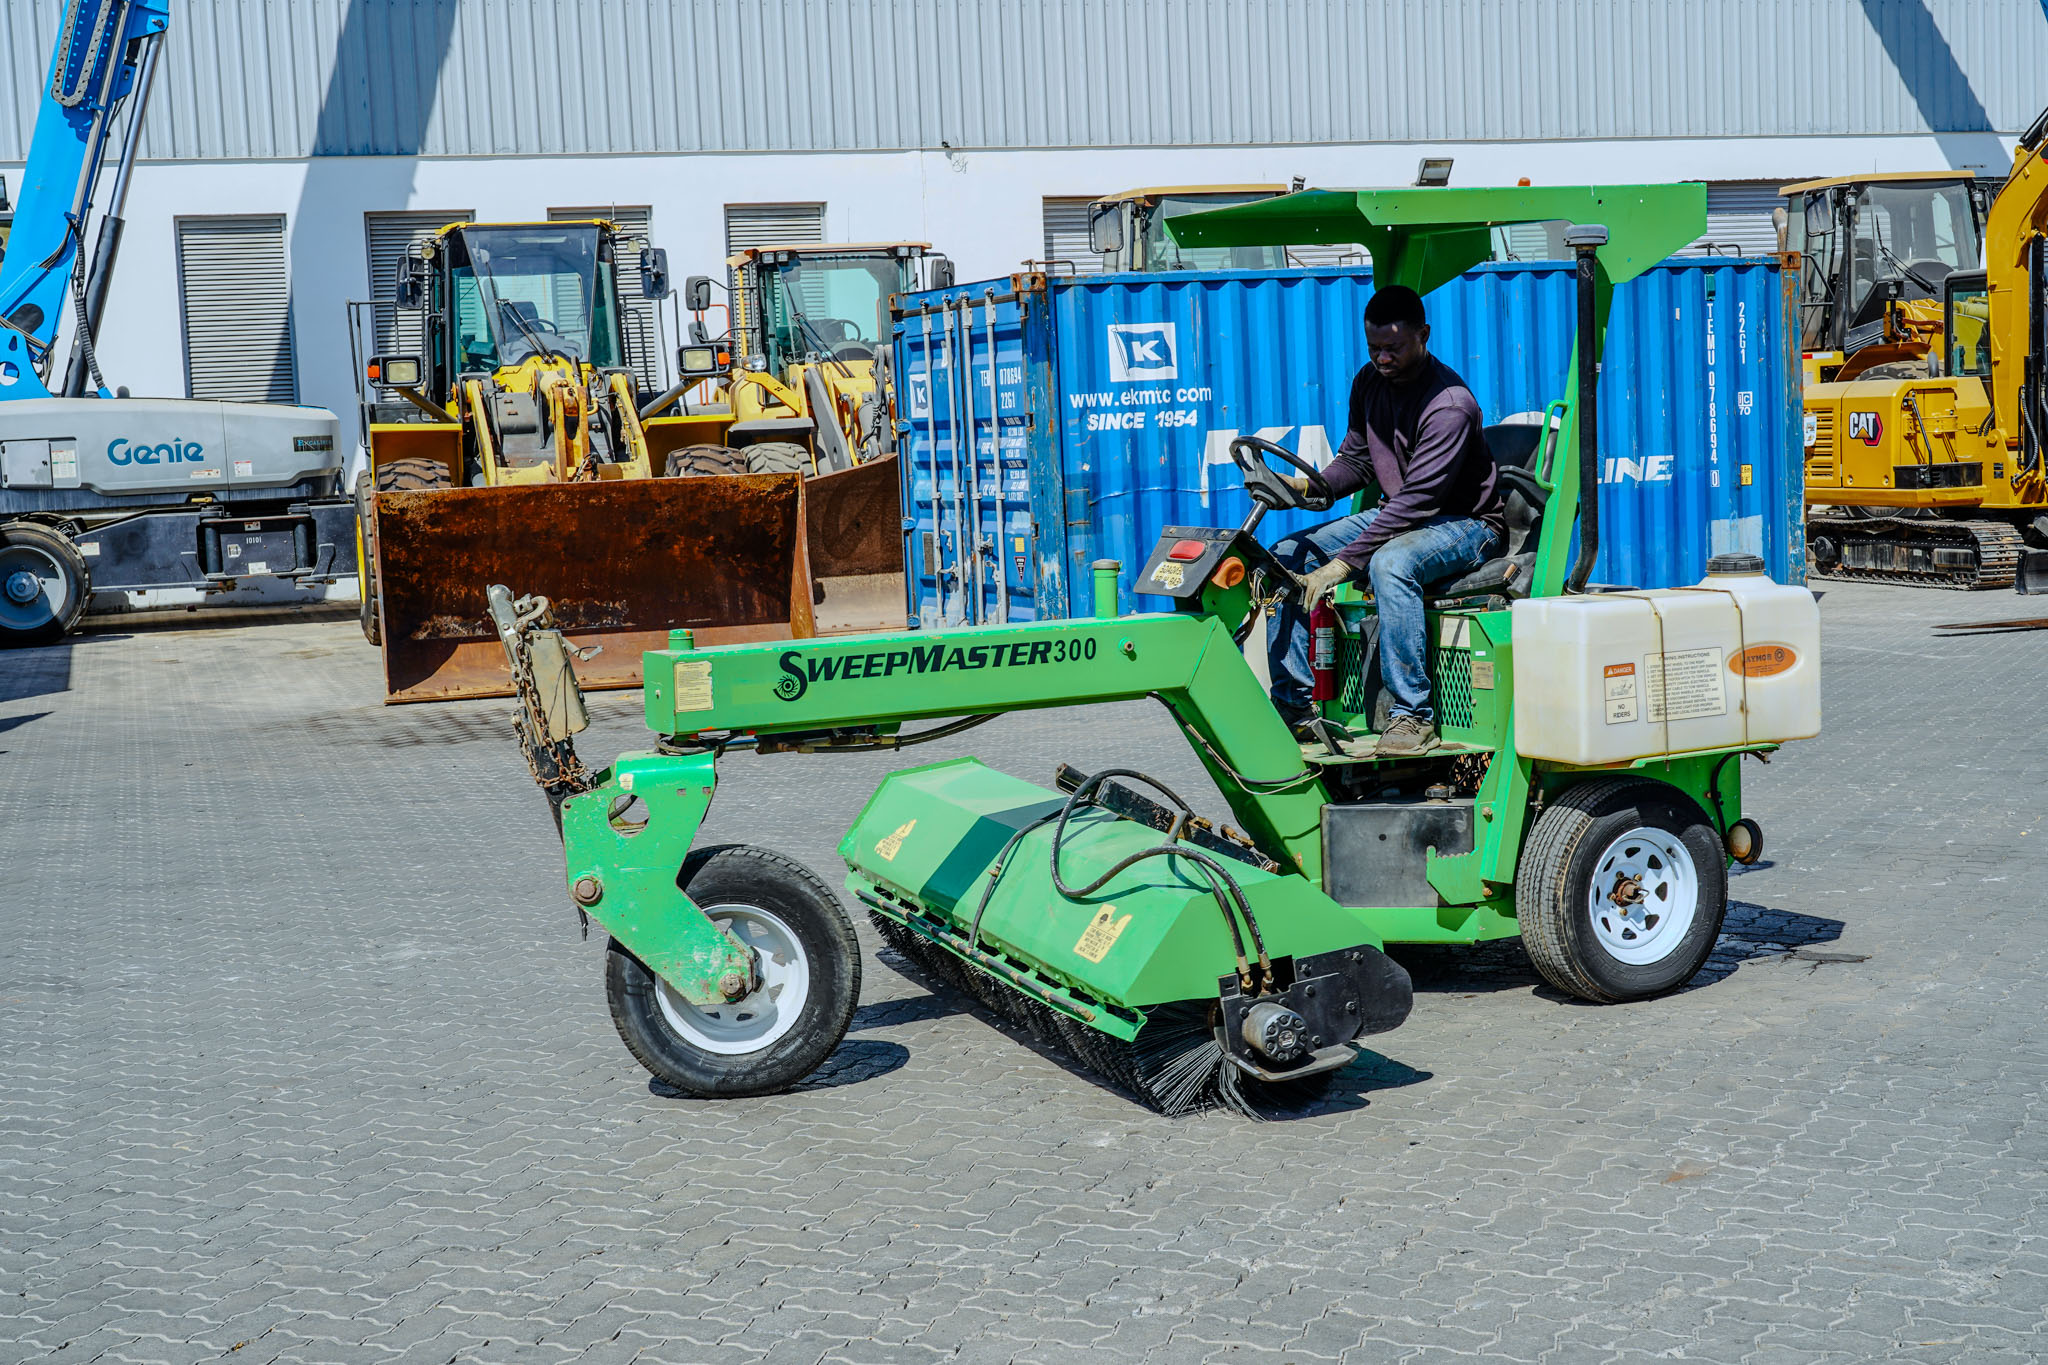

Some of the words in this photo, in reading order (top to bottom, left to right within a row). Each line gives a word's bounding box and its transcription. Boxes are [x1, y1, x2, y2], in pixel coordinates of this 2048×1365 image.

[1706, 302, 1716, 366] TEMU
[1738, 301, 1747, 365] 22G1
[1131, 340, 1163, 362] K
[999, 366, 1022, 386] 078694
[916, 387, 926, 404] K
[1176, 386, 1212, 403] com
[1087, 411, 1146, 431] SINCE
[1154, 409, 1198, 428] 1954
[1708, 371, 1718, 465] 078694
[1739, 406, 1751, 416] 70
[1849, 411, 1876, 439] CAT
[107, 437, 205, 466] Genie
[1597, 454, 1674, 485] INE
[1613, 666, 1633, 674] DANGER
[1613, 710, 1631, 719] RIDERS
